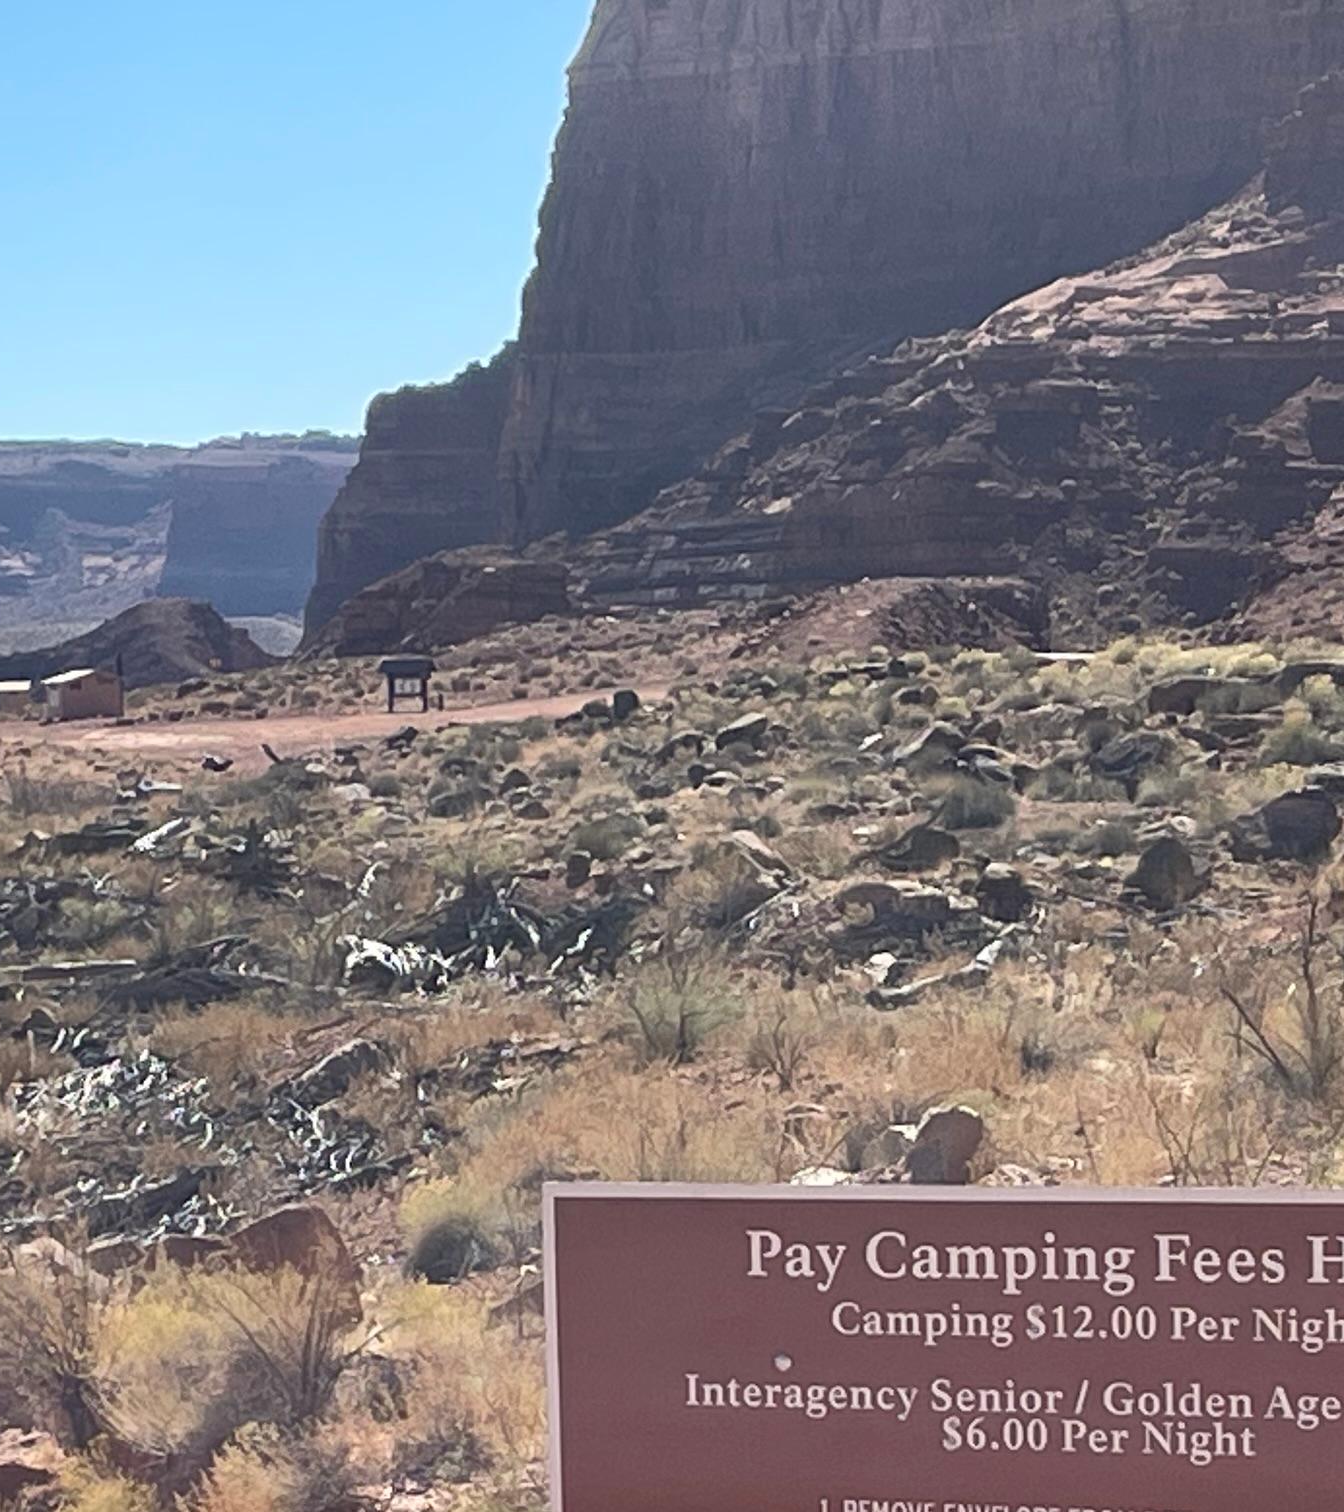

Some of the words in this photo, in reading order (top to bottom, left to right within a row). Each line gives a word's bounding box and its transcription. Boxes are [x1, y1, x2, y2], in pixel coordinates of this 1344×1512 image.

[745, 1229, 847, 1293] Pay
[865, 1230, 1136, 1297] Camping
[1152, 1233, 1286, 1284] Fees
[831, 1301, 1014, 1348] Camping
[1025, 1303, 1157, 1341] $12.00
[1169, 1306, 1240, 1342] Per
[684, 1373, 919, 1422] Interagency
[930, 1378, 1064, 1414] Senior
[1074, 1379, 1089, 1415] /
[1102, 1381, 1254, 1419] Golden
[1263, 1385, 1342, 1430] Age
[942, 1415, 1048, 1452] $6.00
[1061, 1418, 1130, 1454] Per
[1141, 1420, 1257, 1466] Night
